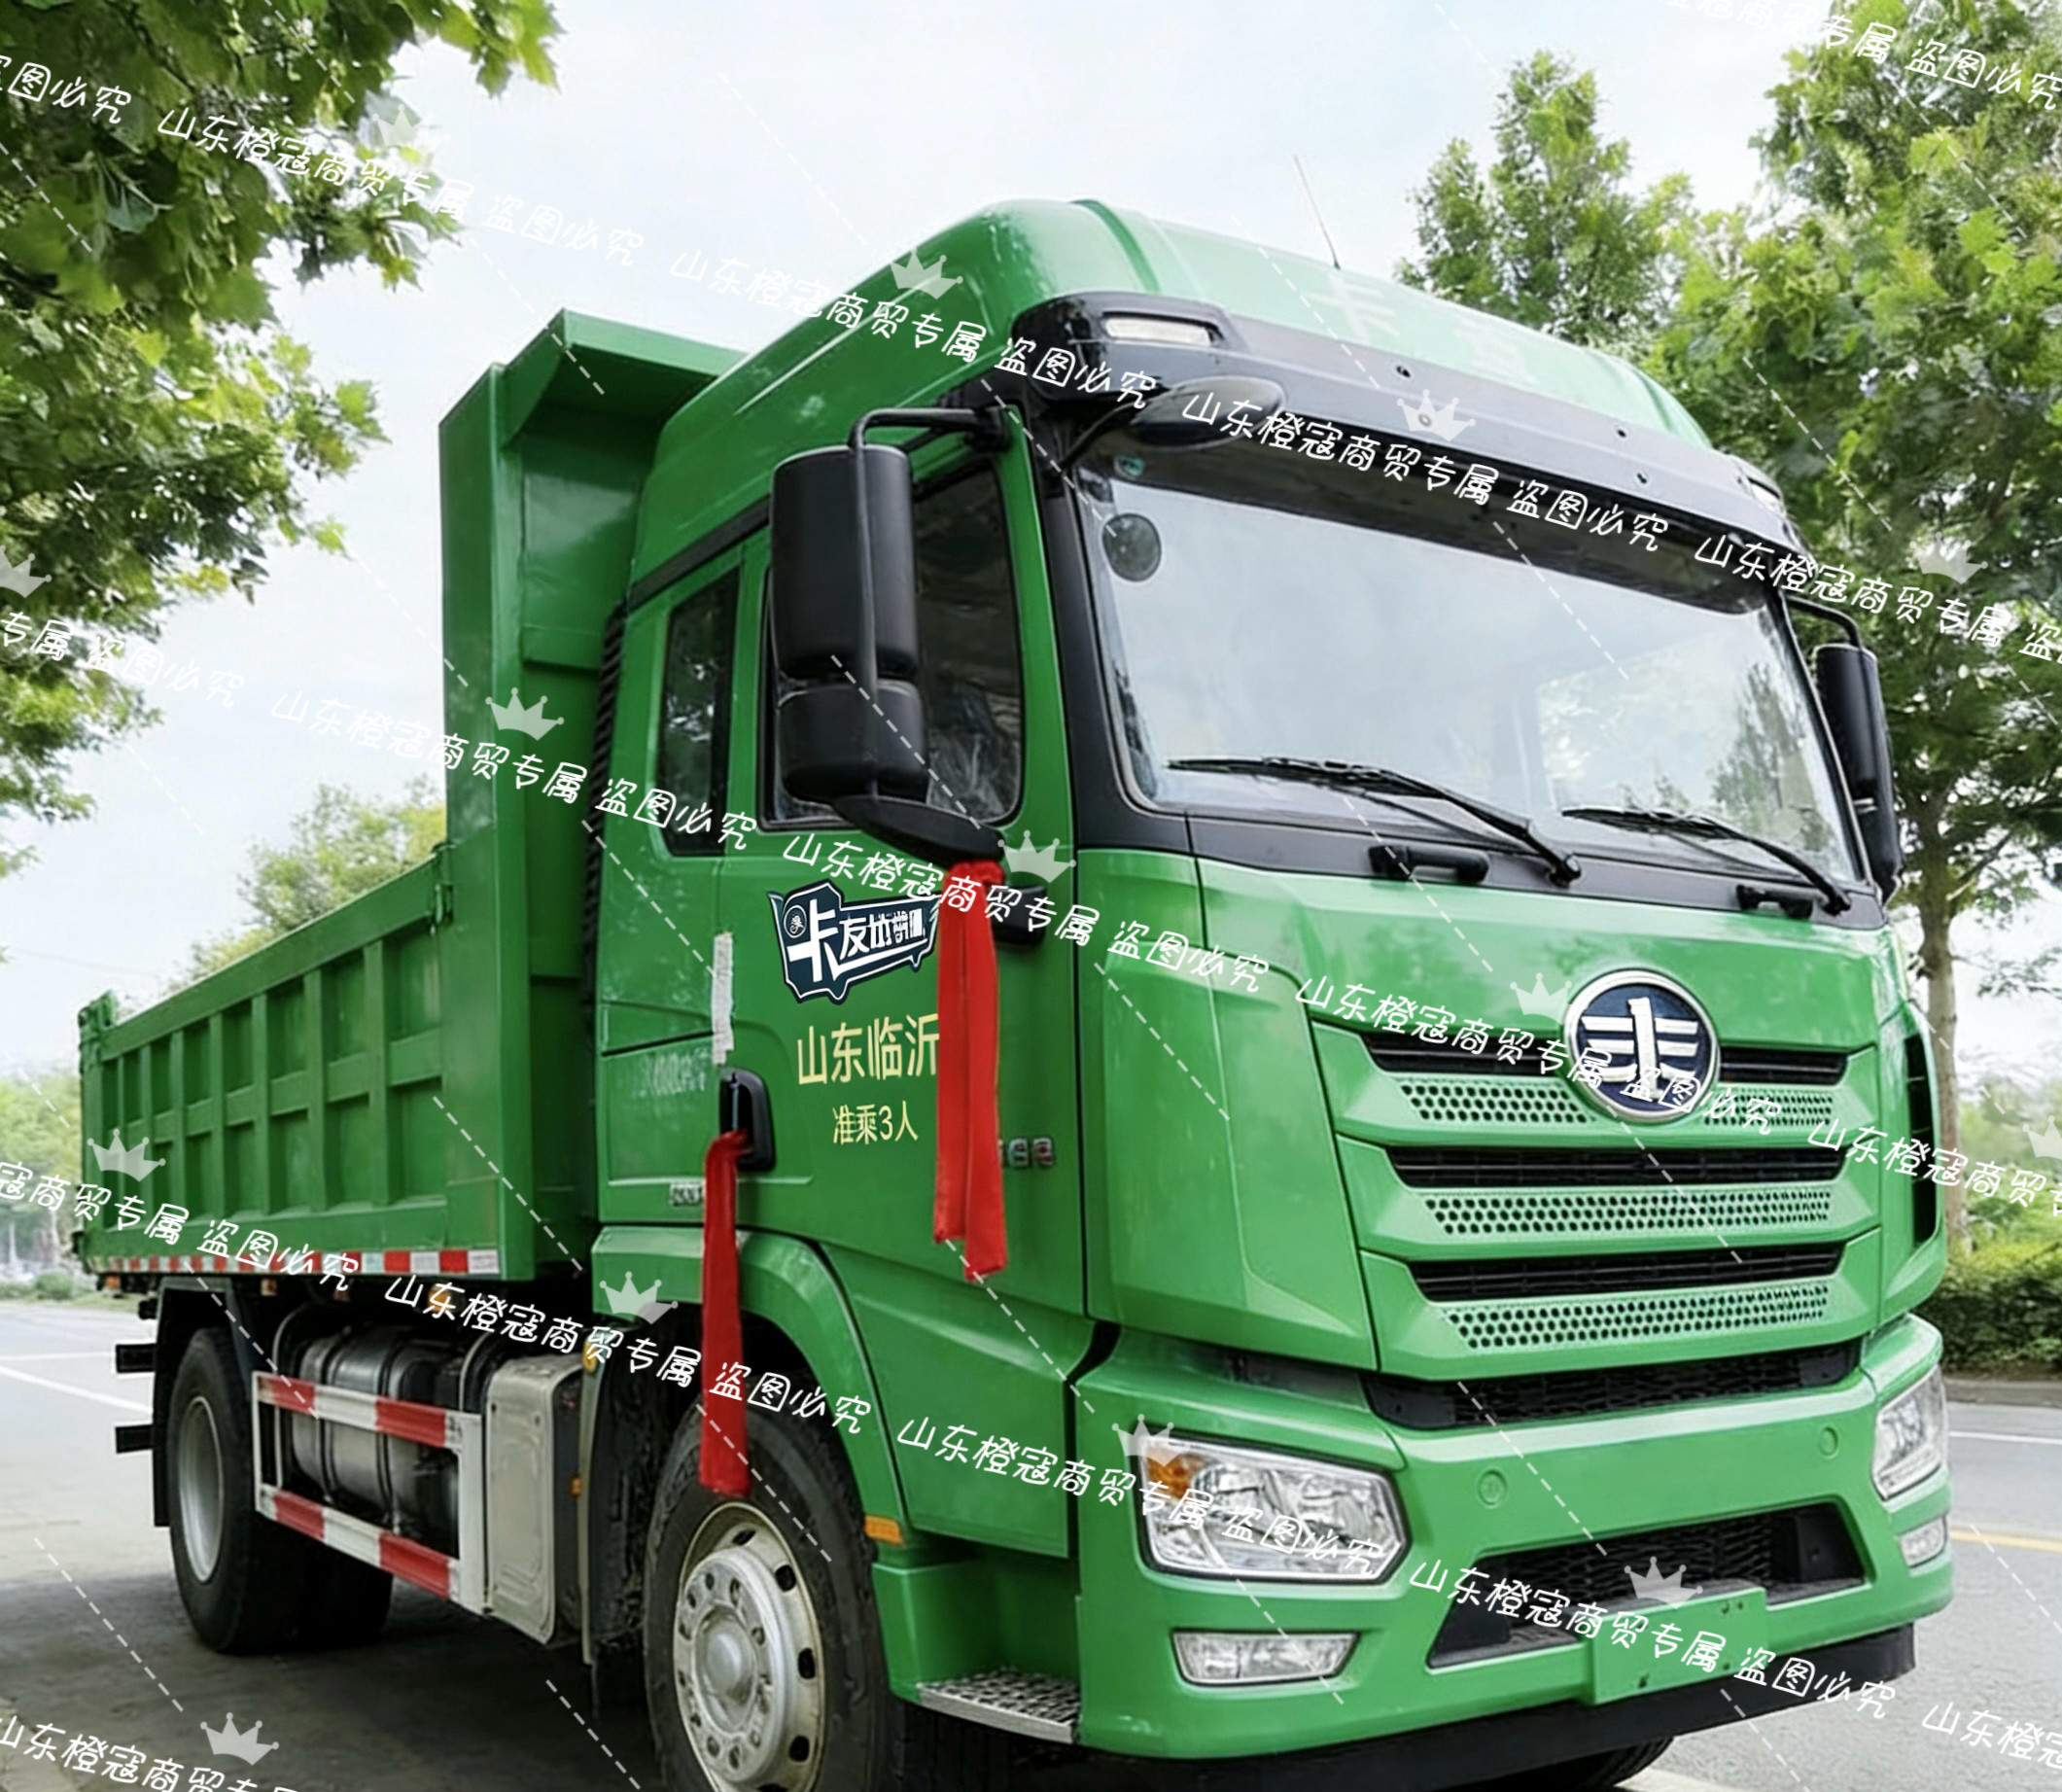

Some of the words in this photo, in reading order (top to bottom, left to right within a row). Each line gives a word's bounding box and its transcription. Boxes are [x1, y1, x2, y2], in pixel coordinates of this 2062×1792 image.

[797, 1013, 940, 1085] 山东临沂
[832, 1100, 919, 1145] 准乘3人
